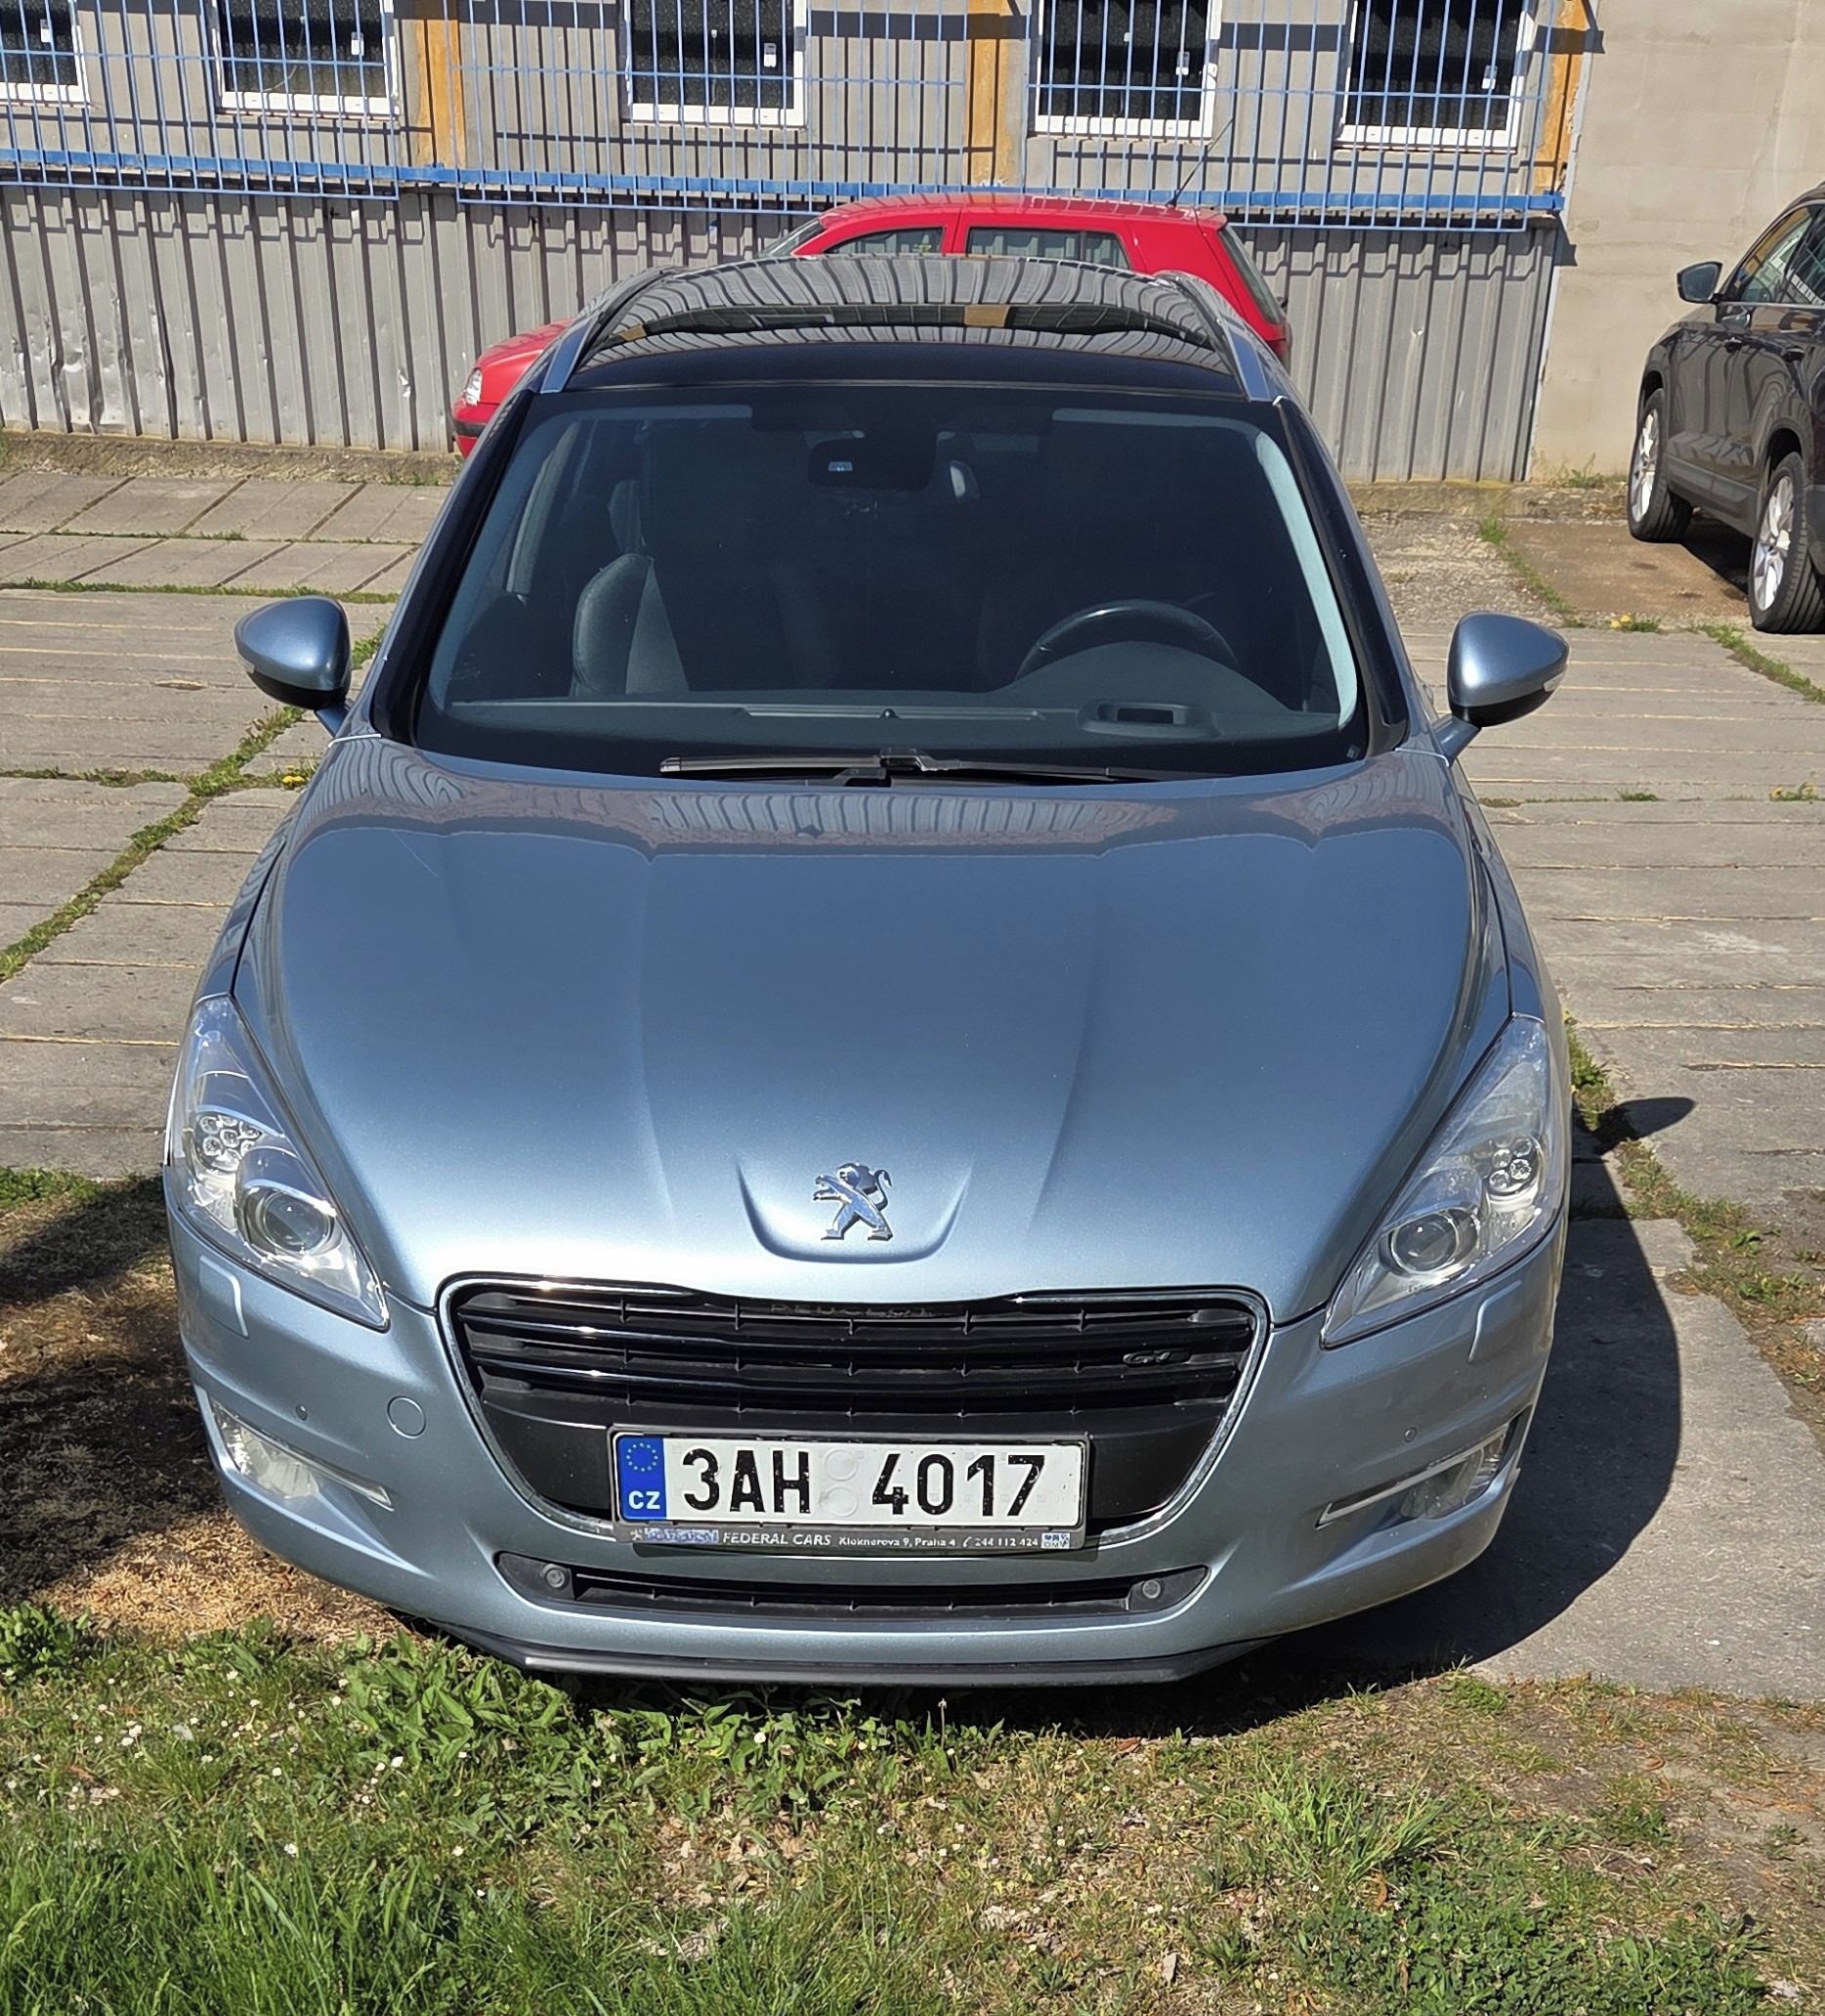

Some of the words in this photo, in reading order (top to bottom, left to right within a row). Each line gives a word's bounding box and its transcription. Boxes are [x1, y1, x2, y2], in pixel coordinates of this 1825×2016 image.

[683, 1447, 811, 1515] 3AH
[871, 1453, 1046, 1517] 4017
[628, 1491, 661, 1511] CZ
[723, 1531, 788, 1546] FEDERAL
[792, 1532, 832, 1546] CARS
[914, 1537, 947, 1547] Praha
[948, 1538, 956, 1547] 4
